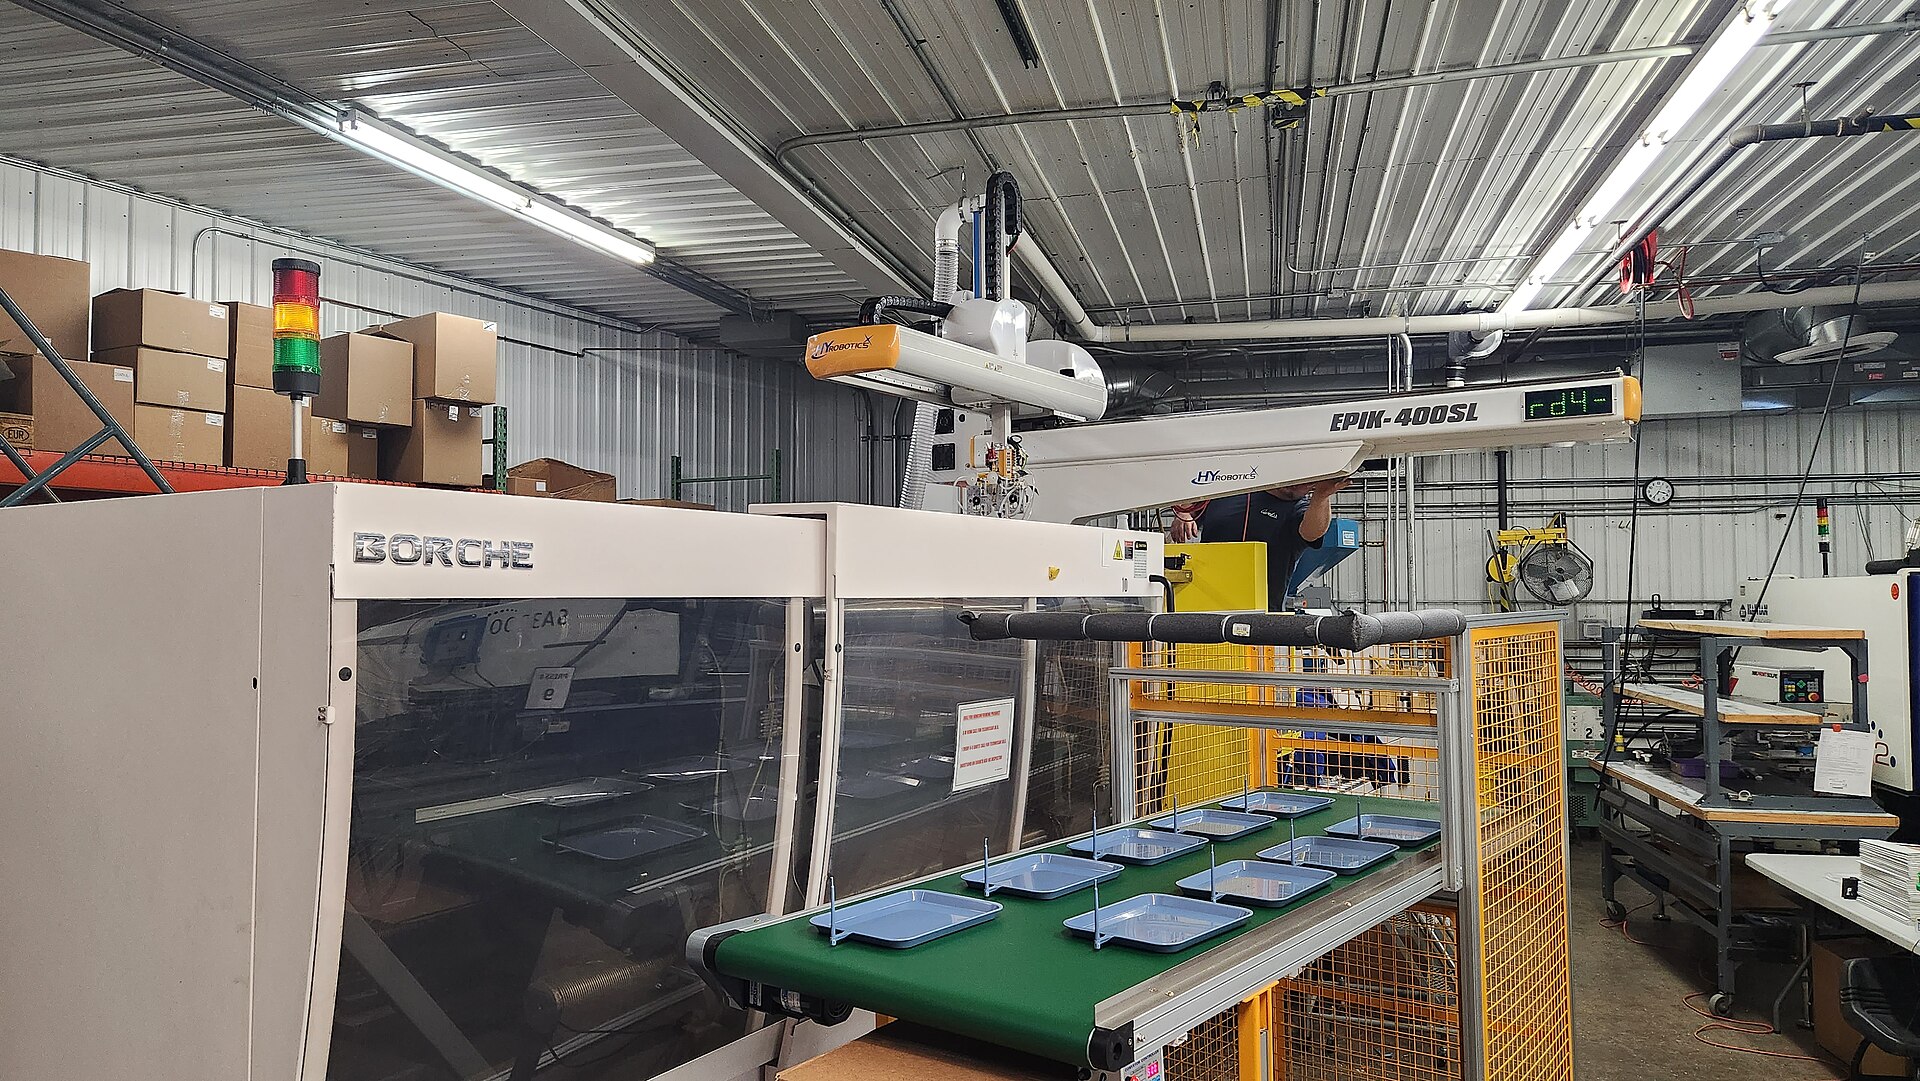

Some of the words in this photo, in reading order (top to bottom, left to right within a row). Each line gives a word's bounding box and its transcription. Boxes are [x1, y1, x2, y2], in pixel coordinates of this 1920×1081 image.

[812, 336, 872, 358] HYROBOTICS
[1329, 402, 1479, 432] EPIK-400SL
[7, 429, 25, 440] EUR
[1191, 466, 1257, 484] HYROBOTICS
[353, 531, 535, 570] BORCHE
[1585, 727, 1593, 739] 2
[1874, 742, 1890, 767] 2
